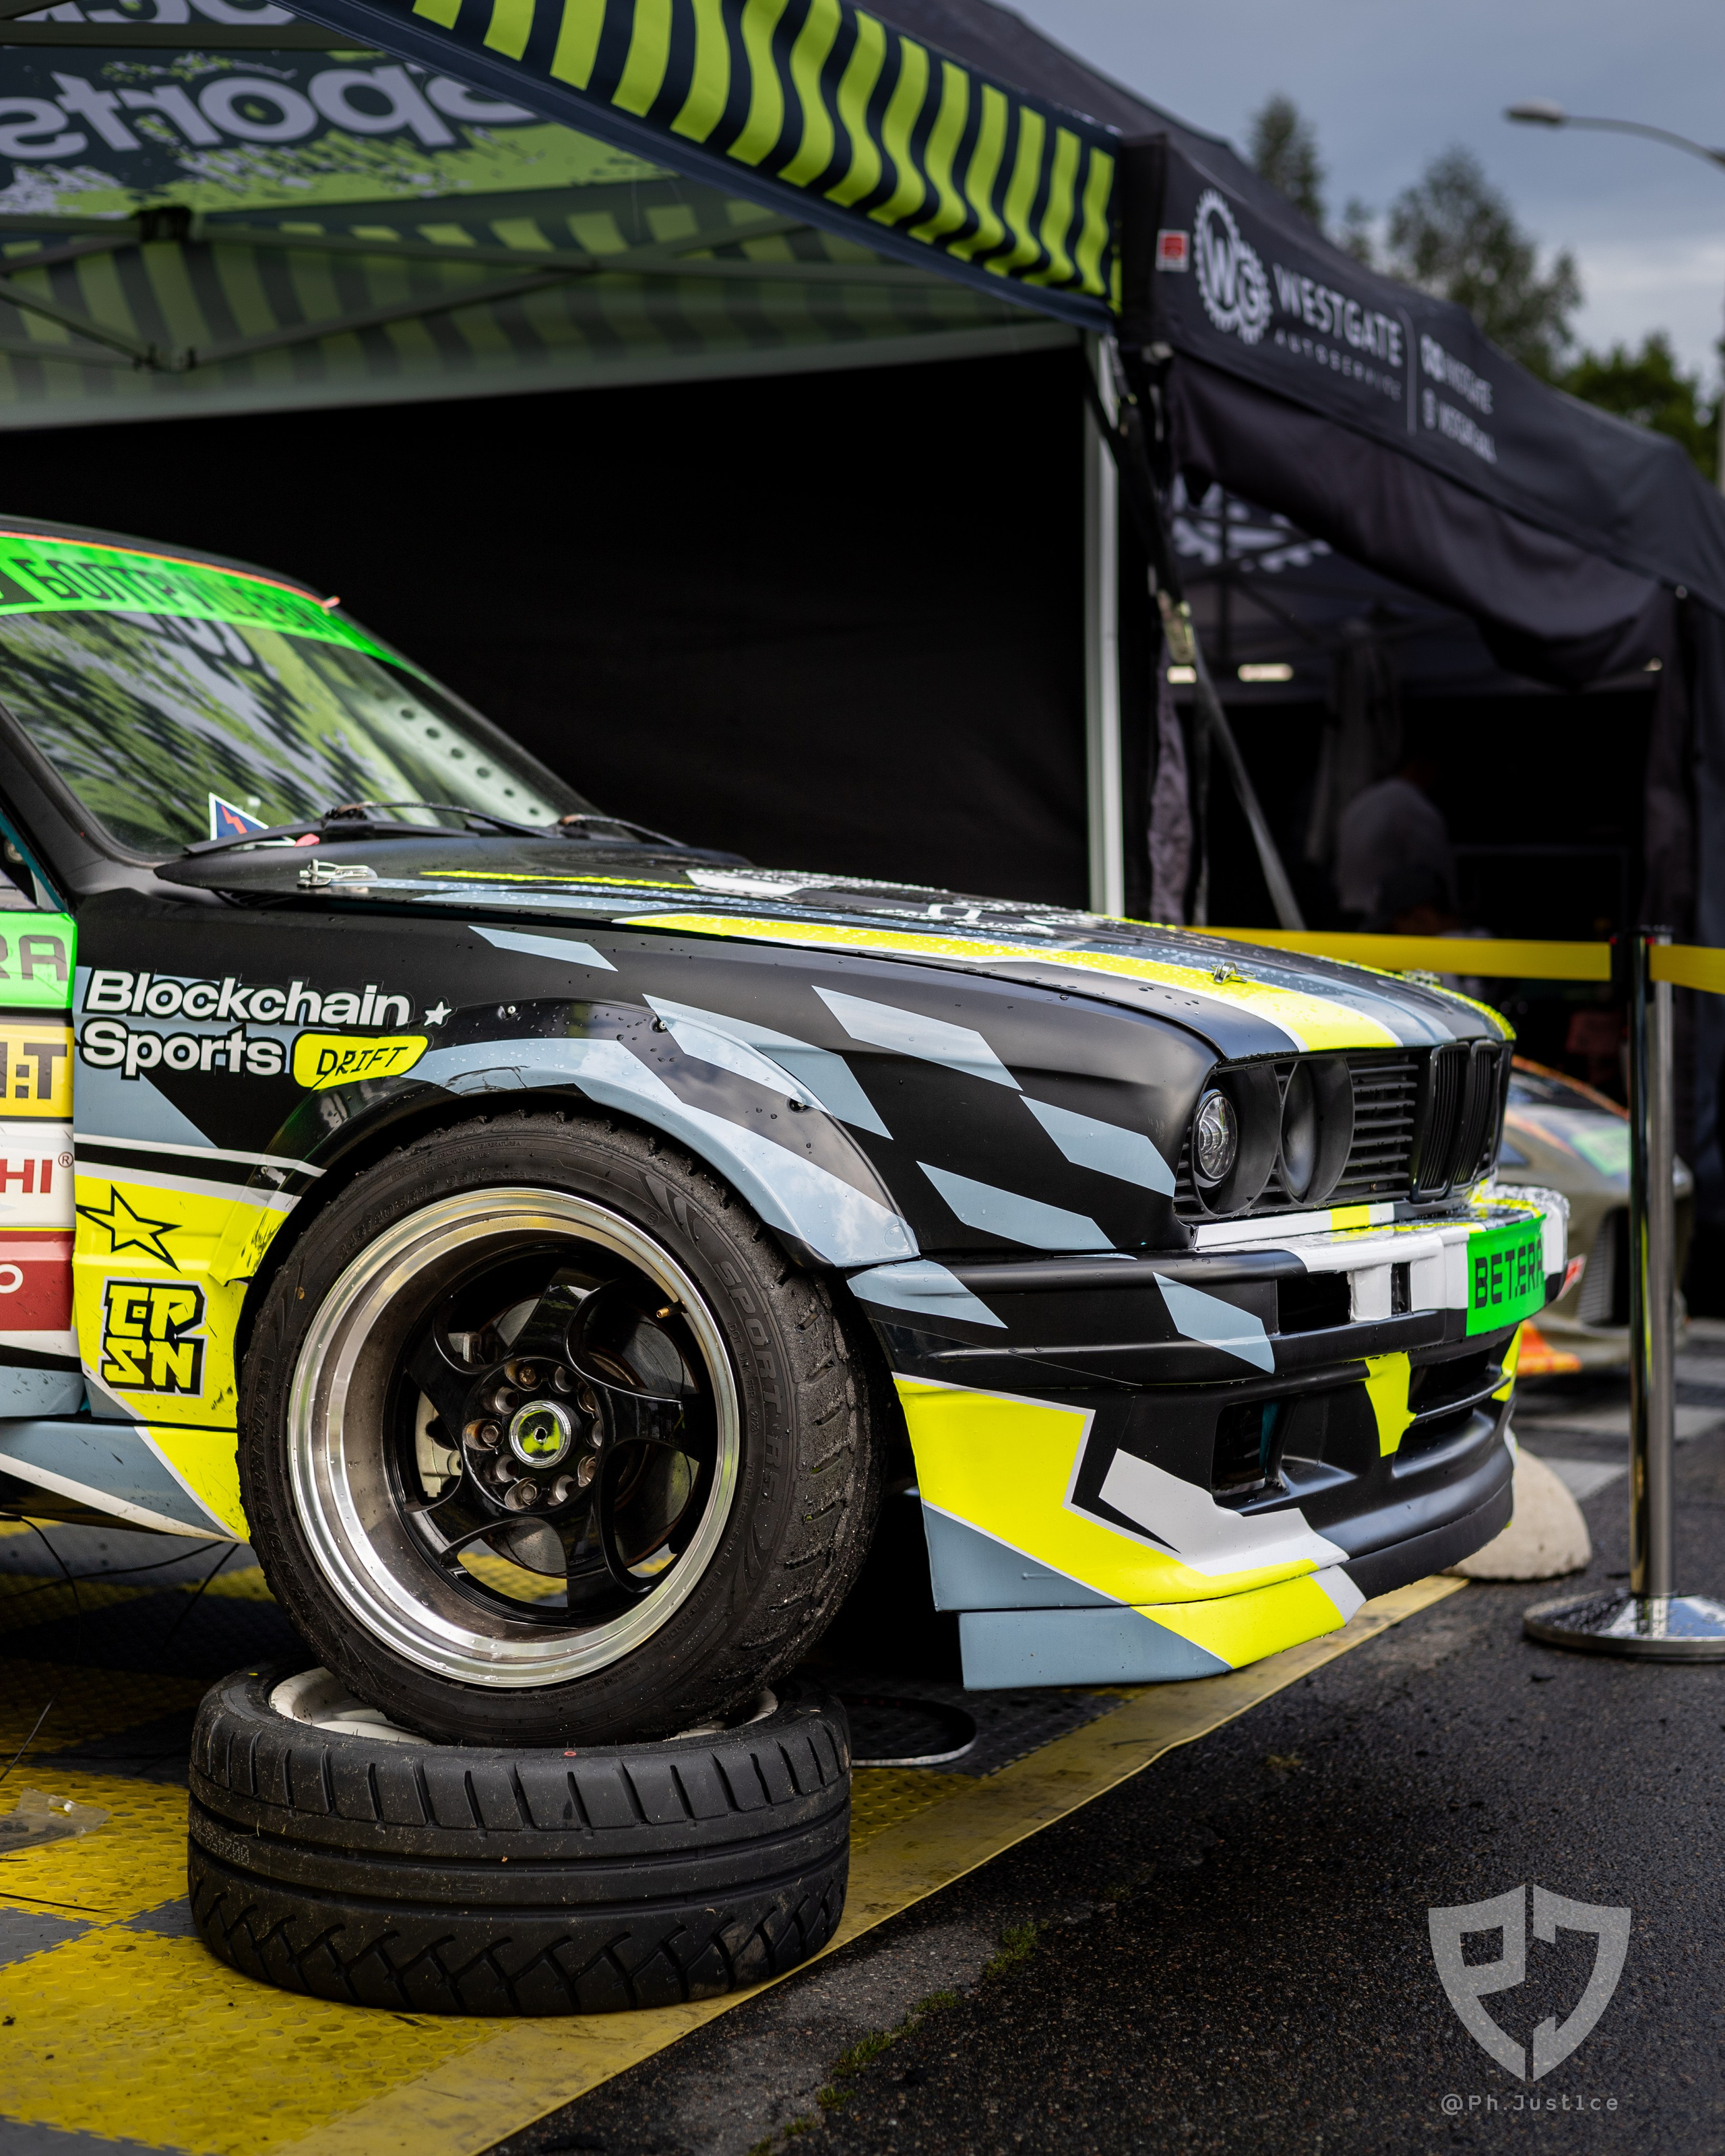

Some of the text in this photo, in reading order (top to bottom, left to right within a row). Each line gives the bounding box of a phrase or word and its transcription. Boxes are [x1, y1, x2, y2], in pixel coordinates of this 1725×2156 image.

[1272, 261, 1403, 368] WESTGATE
[0, 934, 68, 981] A
[86, 970, 410, 1026] Blockchain
[82, 1021, 284, 1076] Sports
[317, 1046, 409, 1077] DRIFT
[729, 1323, 743, 1344] DOT
[712, 1260, 783, 1503] SPORT RS
